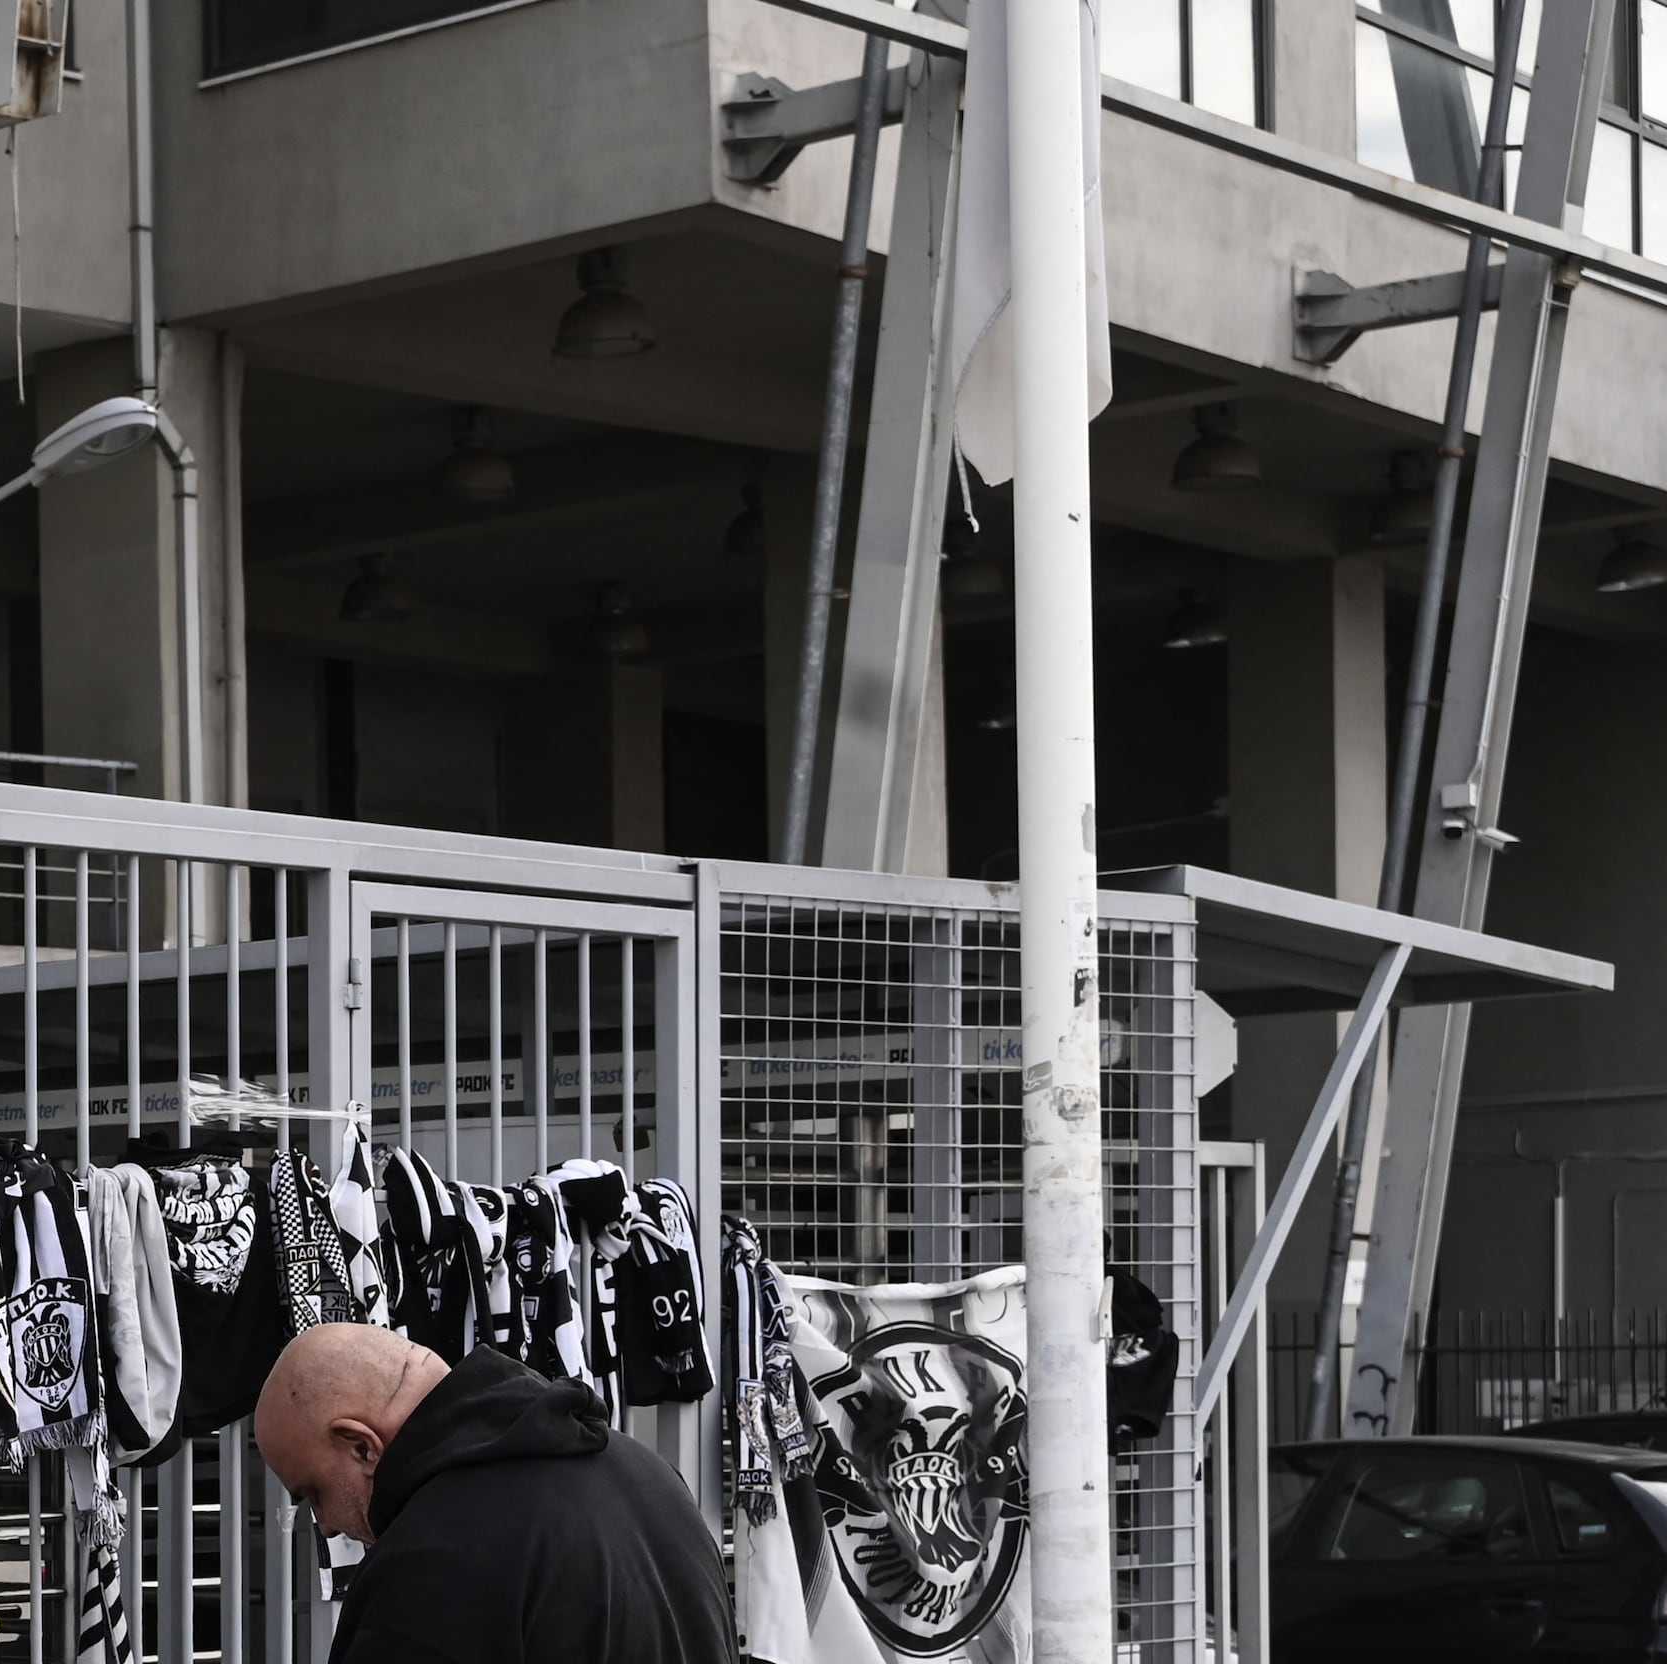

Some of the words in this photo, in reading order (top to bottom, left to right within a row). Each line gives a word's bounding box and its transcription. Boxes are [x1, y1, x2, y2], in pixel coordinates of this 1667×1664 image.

[112, 1098, 128, 1114] FC
[651, 1288, 693, 1331] 92
[893, 1457, 956, 1479] ΠΑΟΚ
[738, 1471, 769, 1485] ΠΑΟΚ
